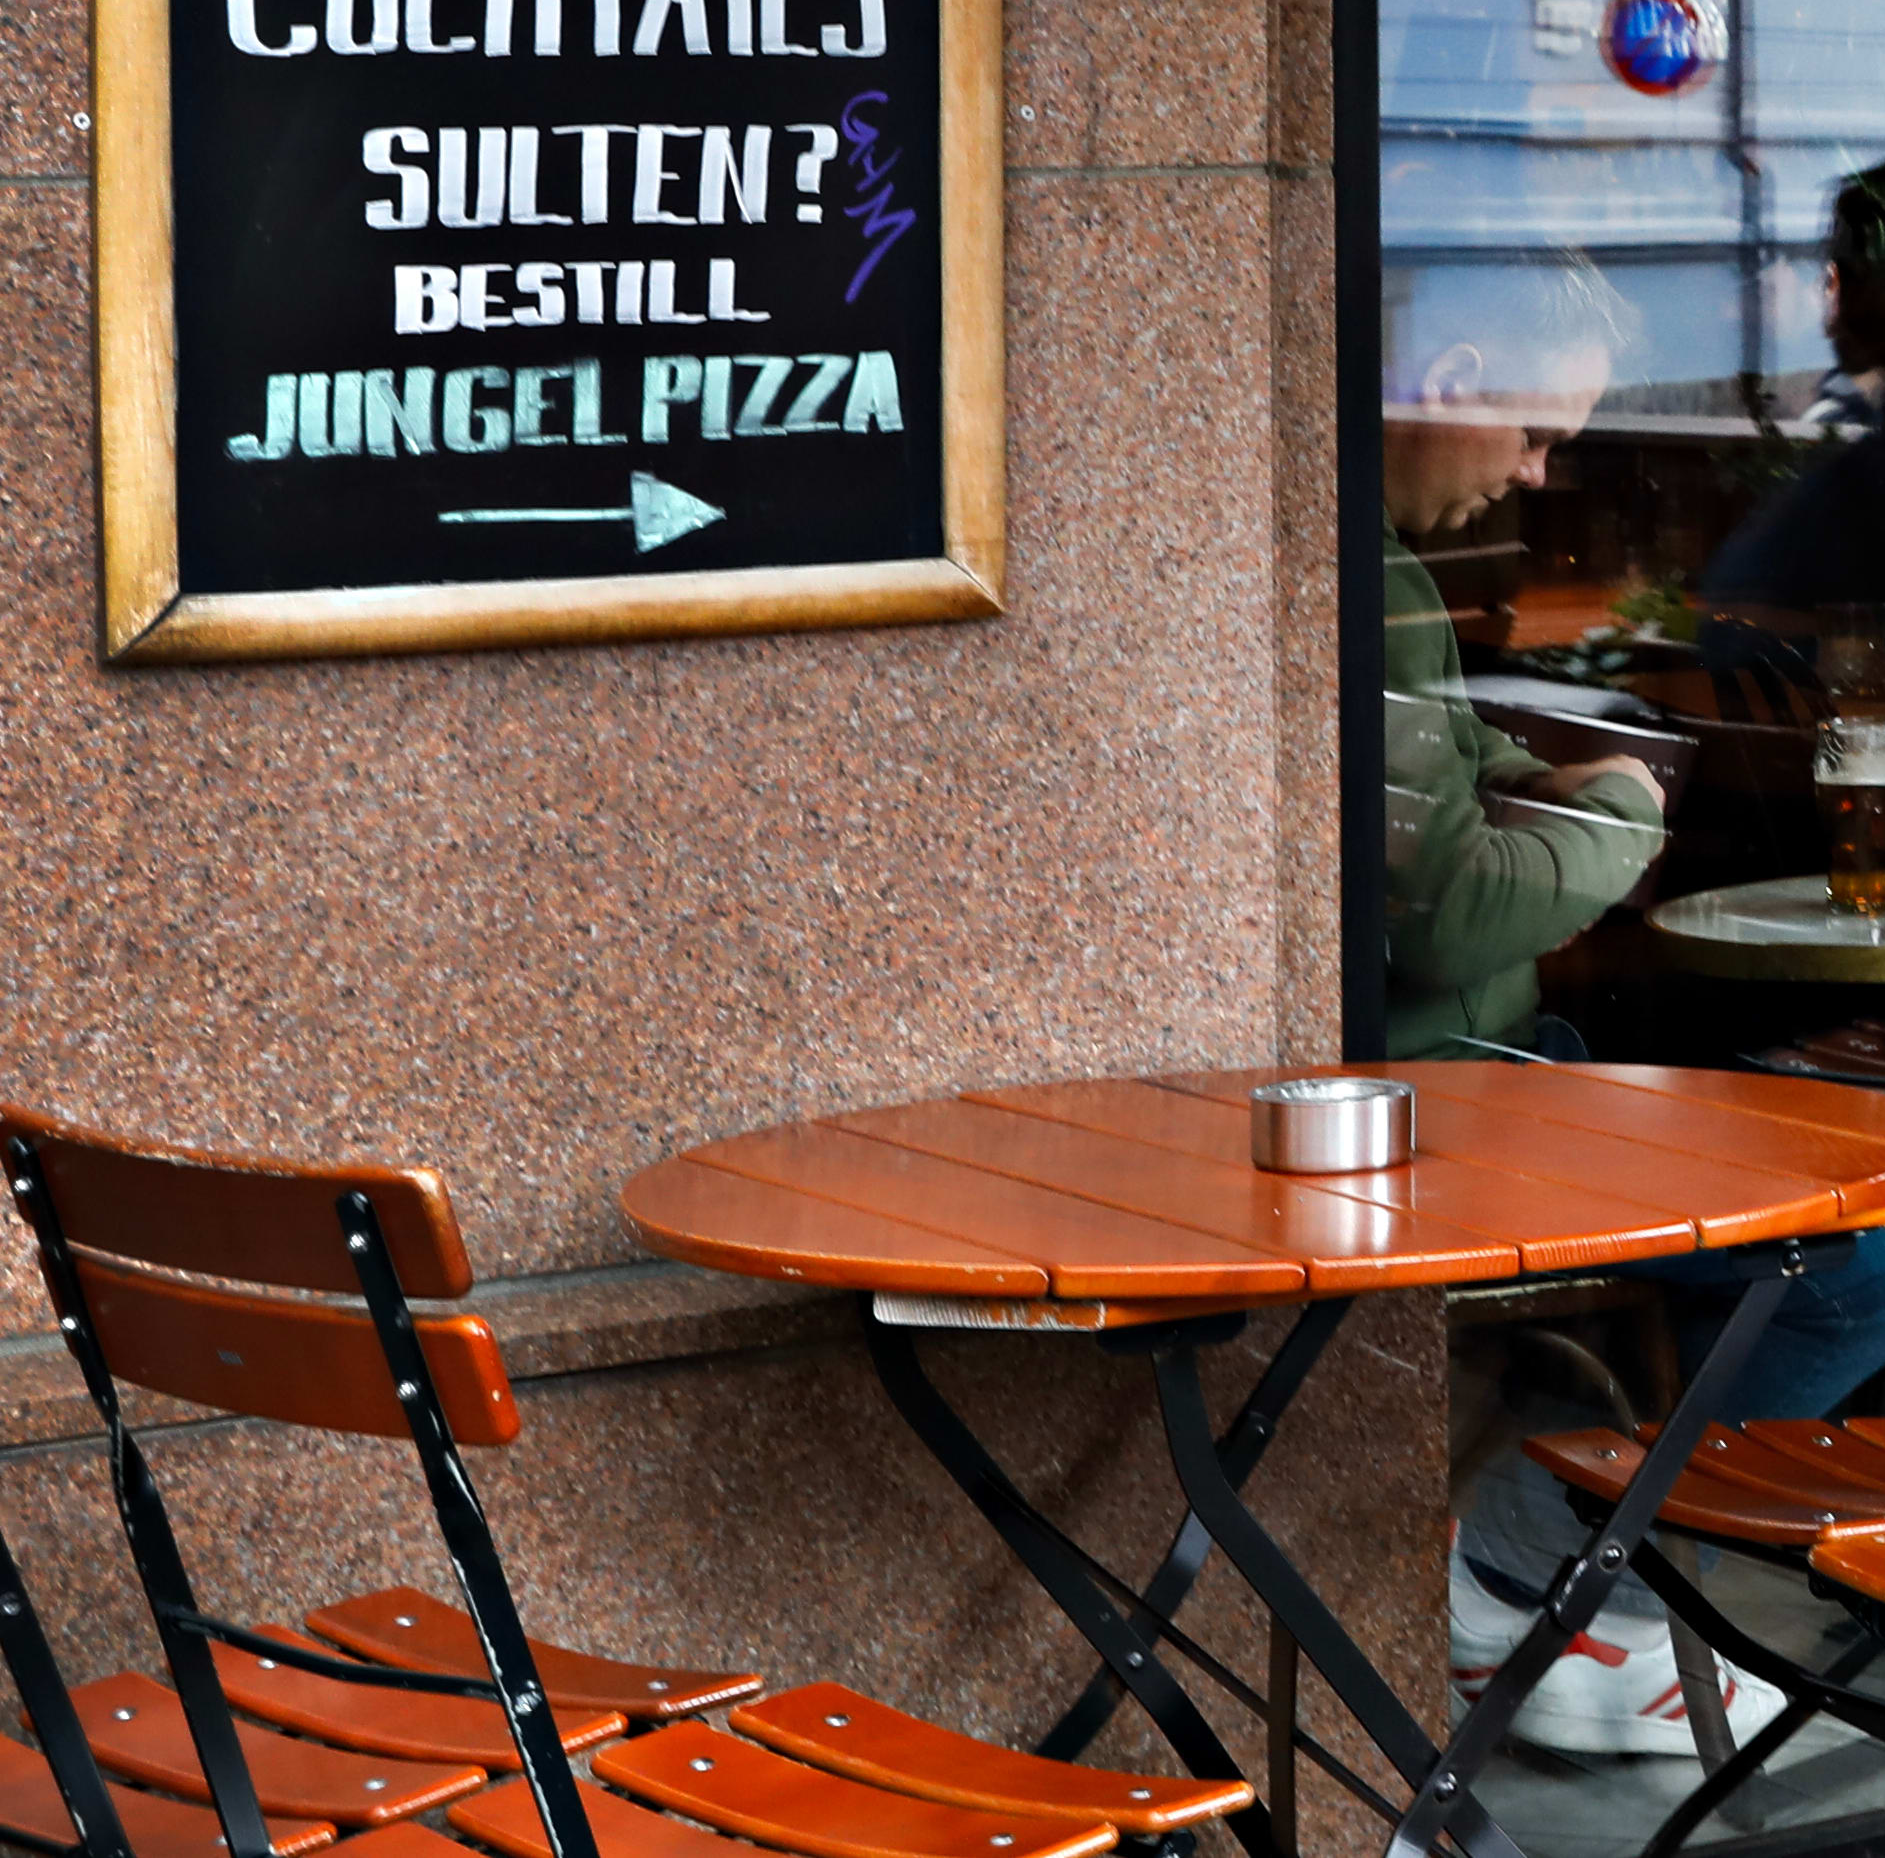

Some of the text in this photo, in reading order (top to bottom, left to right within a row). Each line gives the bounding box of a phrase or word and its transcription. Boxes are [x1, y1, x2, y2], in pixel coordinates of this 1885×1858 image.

[362, 124, 840, 230] SULTEN?
[394, 258, 772, 335] BESTILL
[225, 349, 906, 462] JUNGEL PIZZA
